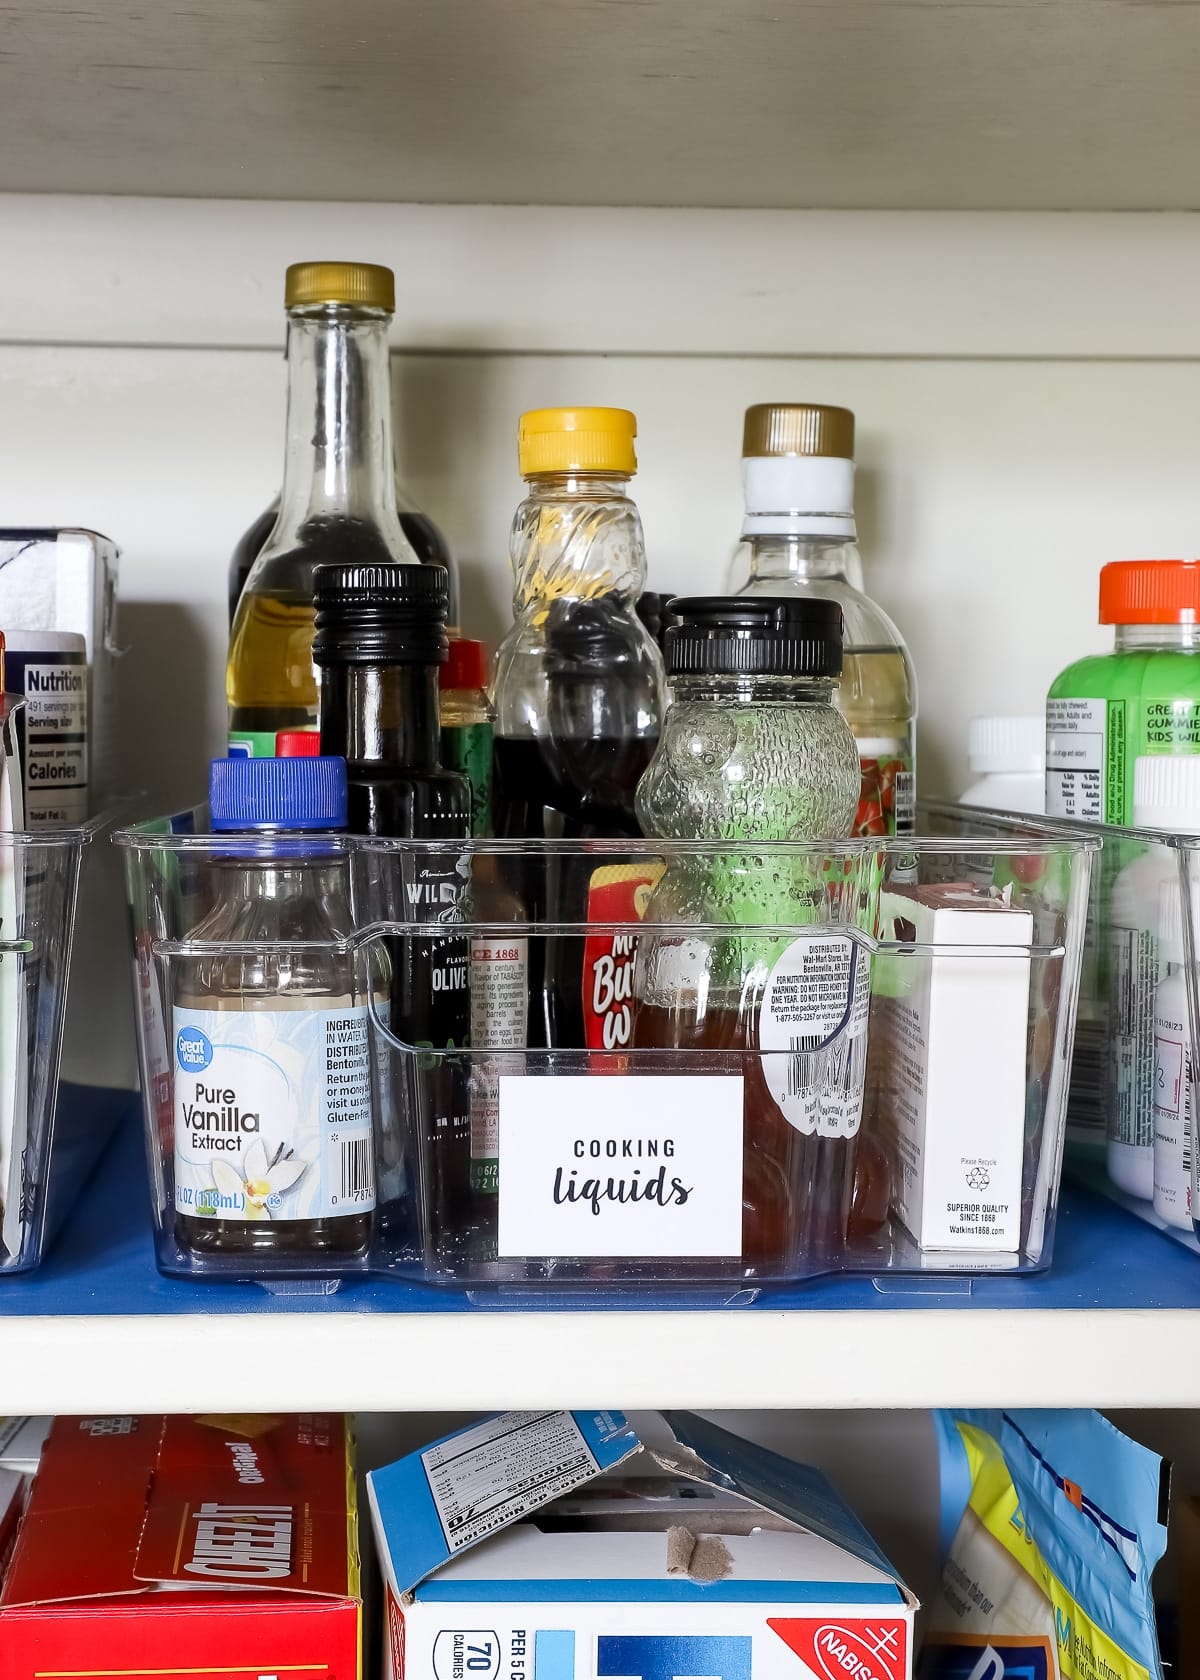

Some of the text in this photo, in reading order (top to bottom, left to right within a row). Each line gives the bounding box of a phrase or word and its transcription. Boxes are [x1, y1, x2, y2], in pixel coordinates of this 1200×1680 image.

[28, 671, 82, 691] Nutrition
[1147, 704, 1187, 716] GRE
[28, 716, 58, 729] Serving
[1147, 731, 1173, 743] KIDS
[28, 762, 77, 780] Calories
[495, 949, 519, 960] 1868
[802, 954, 828, 964] Wal-Mart
[432, 968, 467, 991] OLIVE
[776, 975, 787, 985] FOR
[787, 975, 809, 984] NUTRITION
[772, 986, 800, 995] WARNING:
[800, 985, 808, 993] DO
[809, 984, 818, 993] NOT
[819, 983, 829, 992] FEED
[771, 996, 783, 1005] ONE
[800, 994, 808, 1003] DO
[809, 993, 818, 1002] NOT
[770, 1005, 790, 1013] Return
[790, 1004, 800, 1012] the
[800, 1004, 820, 1013] package
[179, 1036, 205, 1055] Great
[326, 1033, 336, 1045] IN
[196, 1083, 236, 1105] Pure
[326, 1088, 338, 1097] or
[327, 1098, 348, 1109] visit
[182, 1102, 260, 1133] Vanilla
[192, 1132, 242, 1151] Extract
[573, 1139, 675, 1158] COOKING
[553, 1165, 694, 1216] liquids
[183, 1187, 246, 1212] OZ (118mL)
[946, 1203, 1009, 1214] SUPERIOR QUALITY
[959, 1213, 996, 1223] SINCE 1868
[949, 1225, 1005, 1235] Watkins1868.com
[528, 1492, 547, 1506] de
[447, 1507, 476, 1529] 70
[454, 1505, 524, 1547] Nutrición
[510, 1629, 526, 1668] PER 5
[453, 1634, 492, 1679] CALORIES 70
